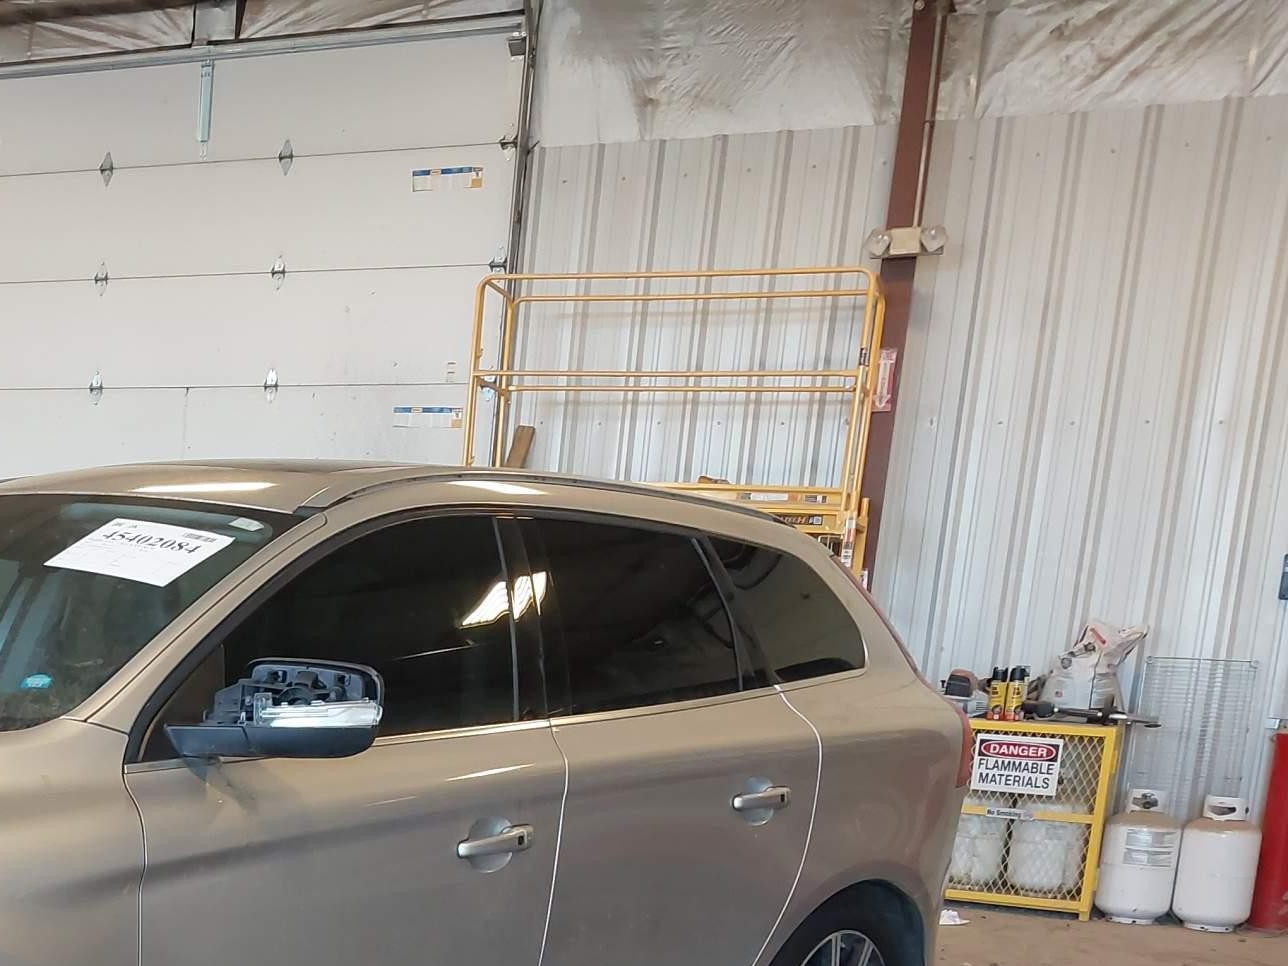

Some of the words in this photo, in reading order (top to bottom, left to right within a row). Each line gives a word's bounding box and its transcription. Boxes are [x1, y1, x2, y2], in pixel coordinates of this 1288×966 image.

[101, 530, 203, 555] 45402084
[989, 743, 1048, 758] DANGER
[977, 758, 1056, 776] FLAMMABLE
[977, 771, 1051, 790] MATERIALS
